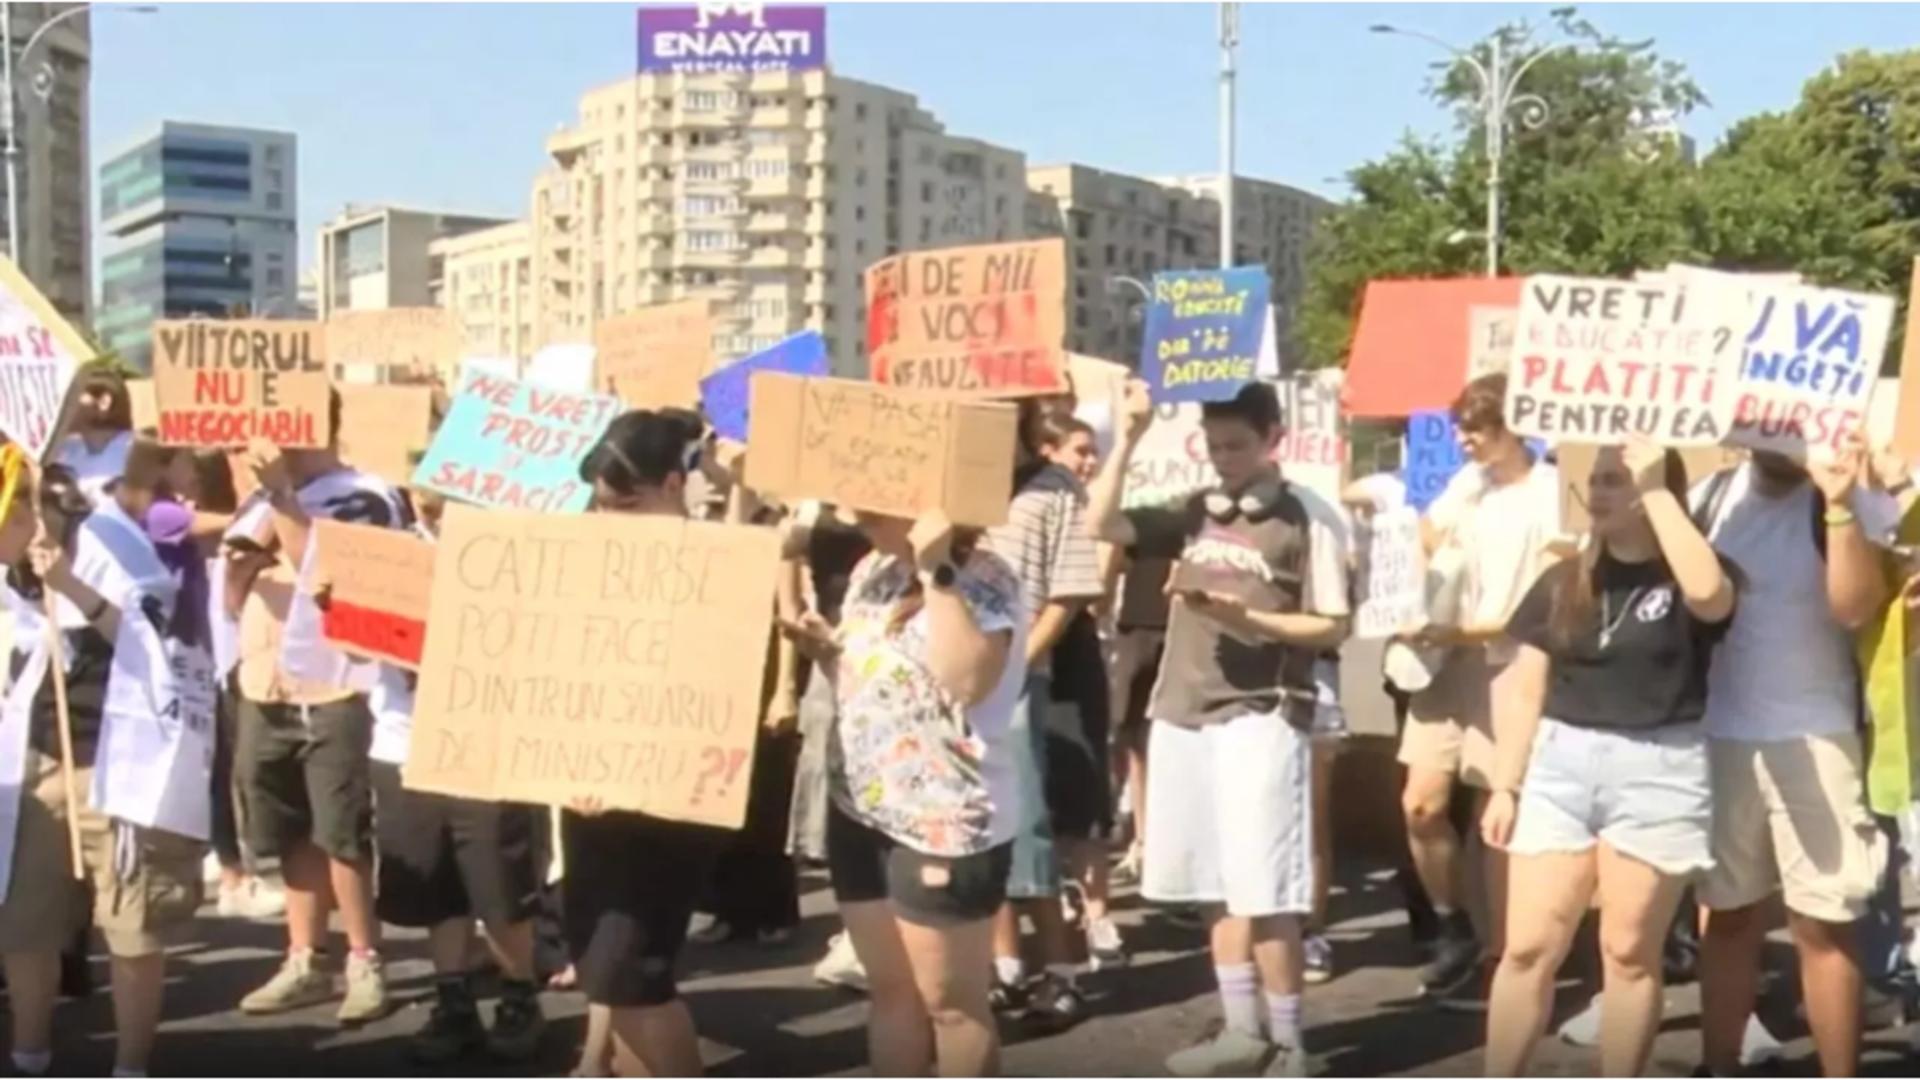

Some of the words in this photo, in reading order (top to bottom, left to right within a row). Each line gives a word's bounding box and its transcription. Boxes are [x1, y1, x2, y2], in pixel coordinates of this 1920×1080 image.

[653, 30, 811, 57] ENAYATI
[922, 255, 966, 297] DE
[159, 322, 324, 369] VIITORUL
[1794, 298, 1868, 364] VĂ
[194, 371, 245, 407] NU
[260, 371, 279, 407] E
[465, 373, 520, 409] NE
[1512, 394, 1663, 437] PENTRU
[1668, 405, 1721, 439] EA
[456, 532, 582, 598] CATE
[599, 537, 731, 607] BURSE
[579, 612, 673, 668] FACE
